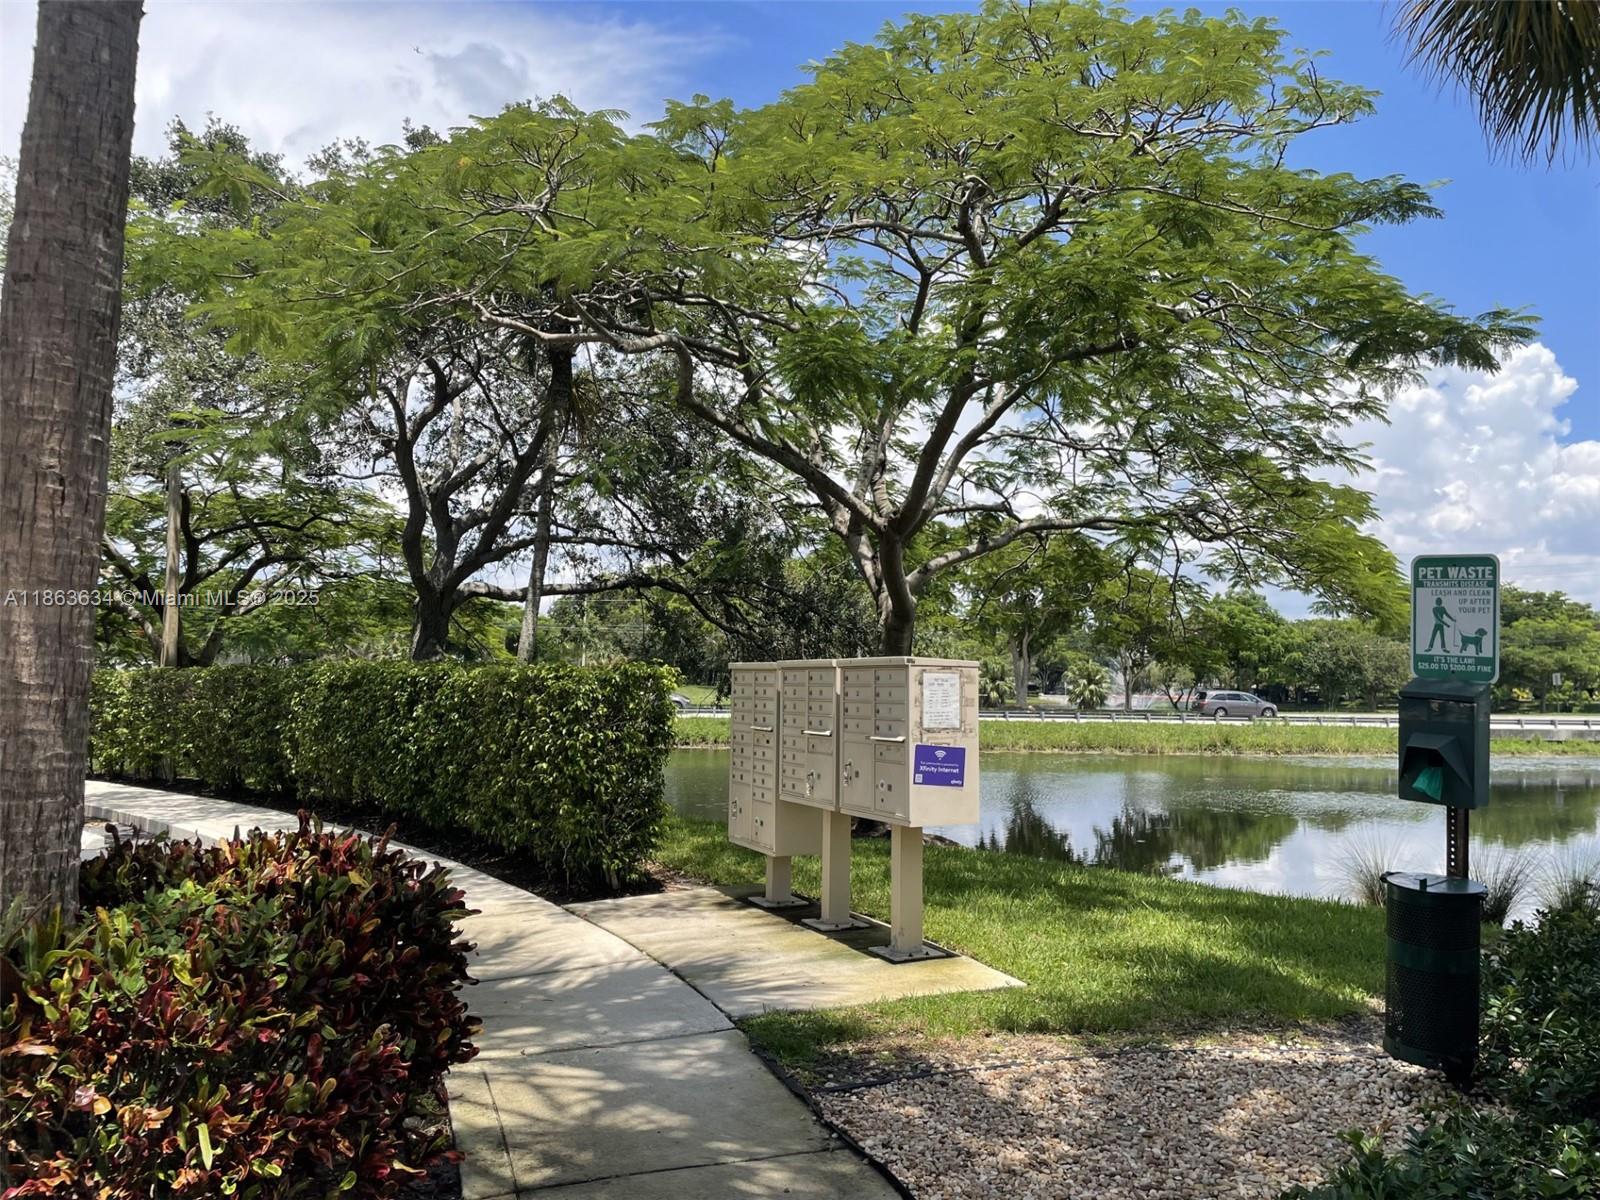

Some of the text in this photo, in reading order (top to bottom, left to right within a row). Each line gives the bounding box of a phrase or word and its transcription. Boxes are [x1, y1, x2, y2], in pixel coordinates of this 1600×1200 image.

[1418, 566, 1494, 580] PET WASTE
[1431, 589, 1452, 597] LEASH
[1454, 589, 1467, 597] AND
